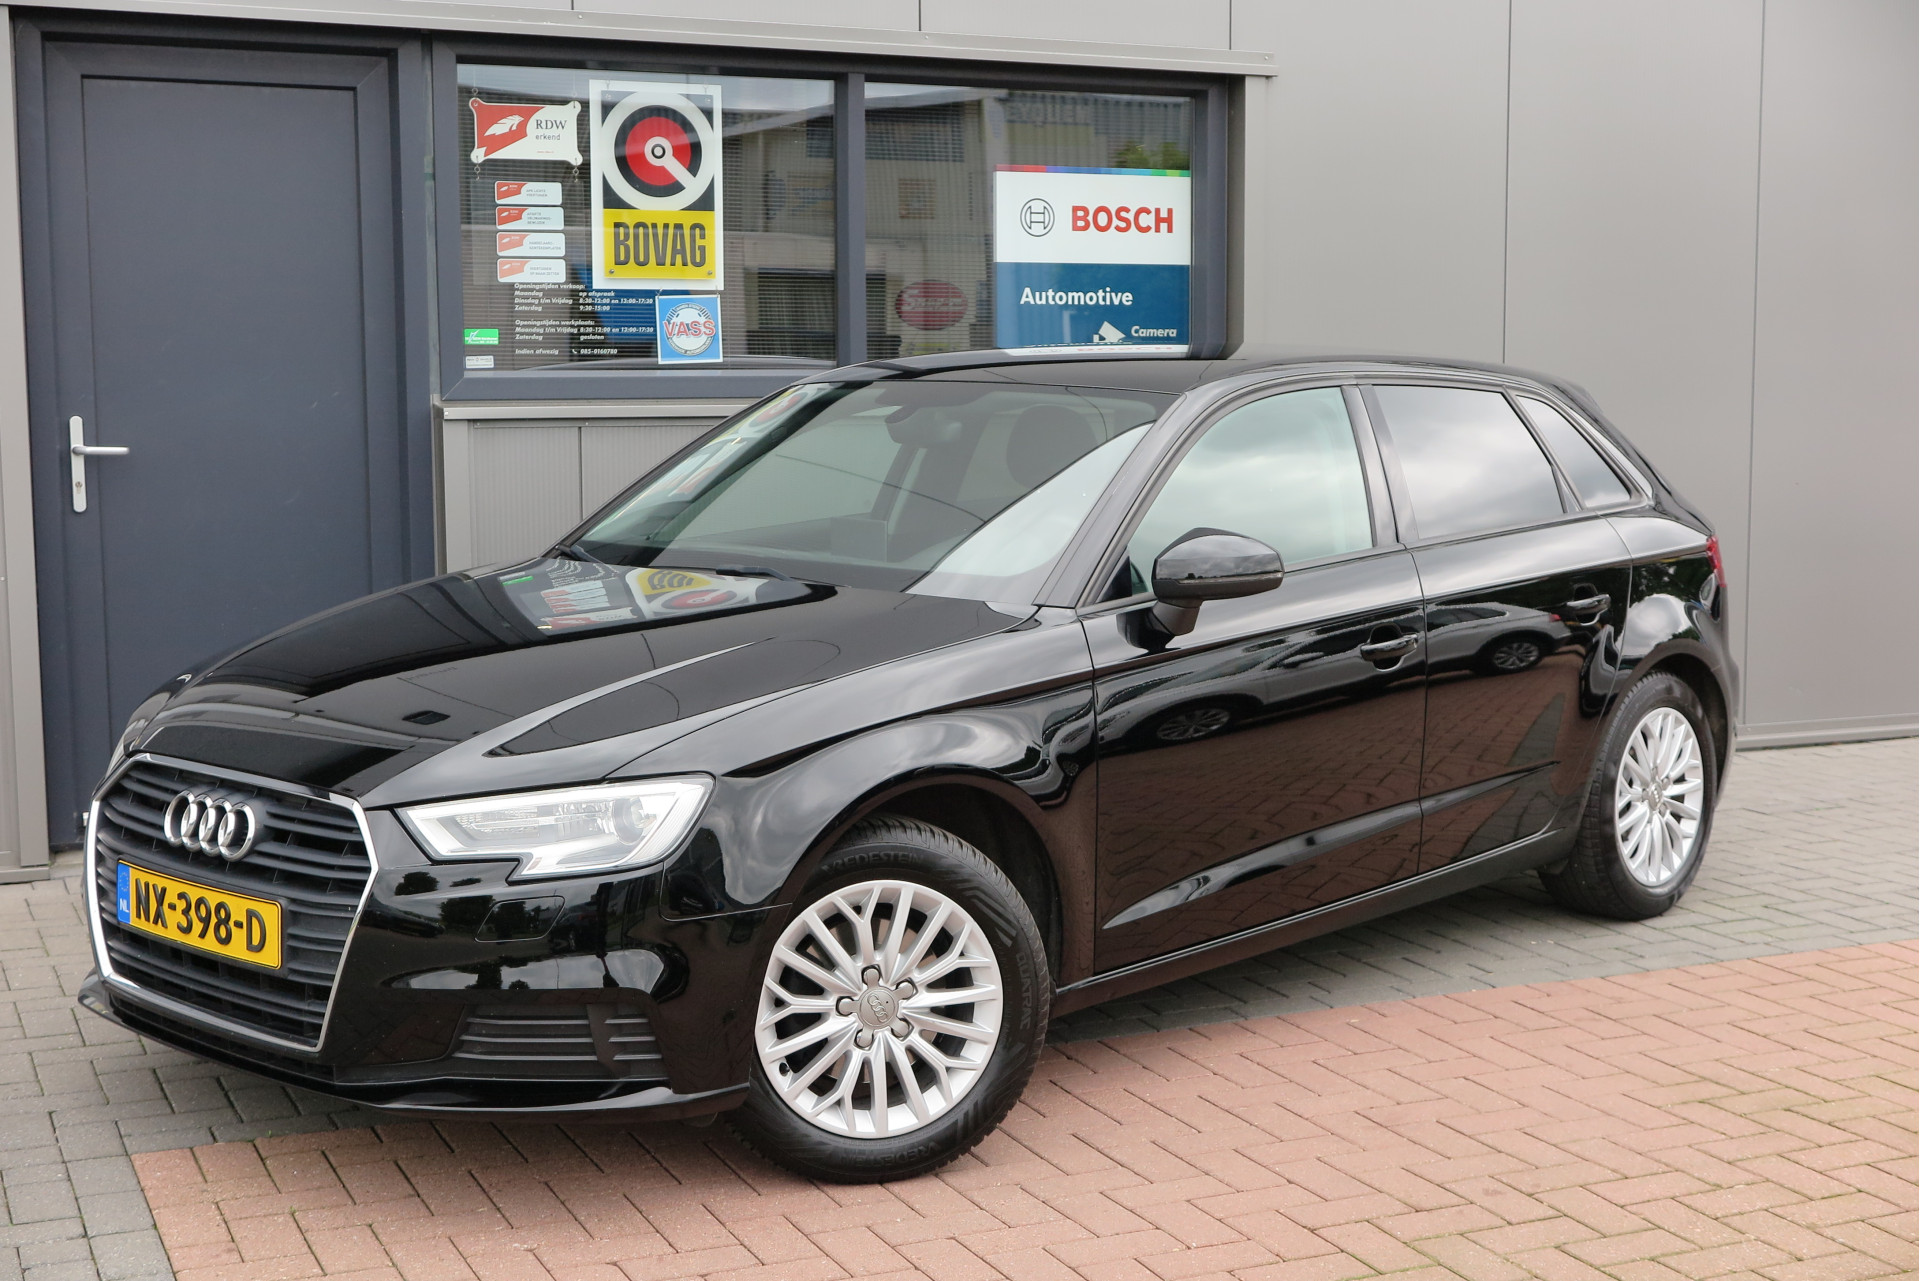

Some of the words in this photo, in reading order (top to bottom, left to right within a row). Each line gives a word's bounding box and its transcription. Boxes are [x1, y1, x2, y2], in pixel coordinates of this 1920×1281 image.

[535, 119, 568, 130] RDW
[535, 133, 561, 141] erkend
[1071, 205, 1174, 233] BOSCH
[612, 221, 706, 268] BOVAG
[514, 297, 539, 305] Dinsdag
[552, 297, 573, 305] Vrijdag
[1019, 286, 1134, 305] Automotive
[515, 326, 544, 334] Maandag
[556, 326, 578, 334] Vrijdag
[663, 320, 716, 337] VASS
[1131, 325, 1177, 338] Camera
[820, 850, 924, 872] VREDESTEIN
[119, 897, 130, 913] NL
[134, 876, 268, 954] NX-398-D
